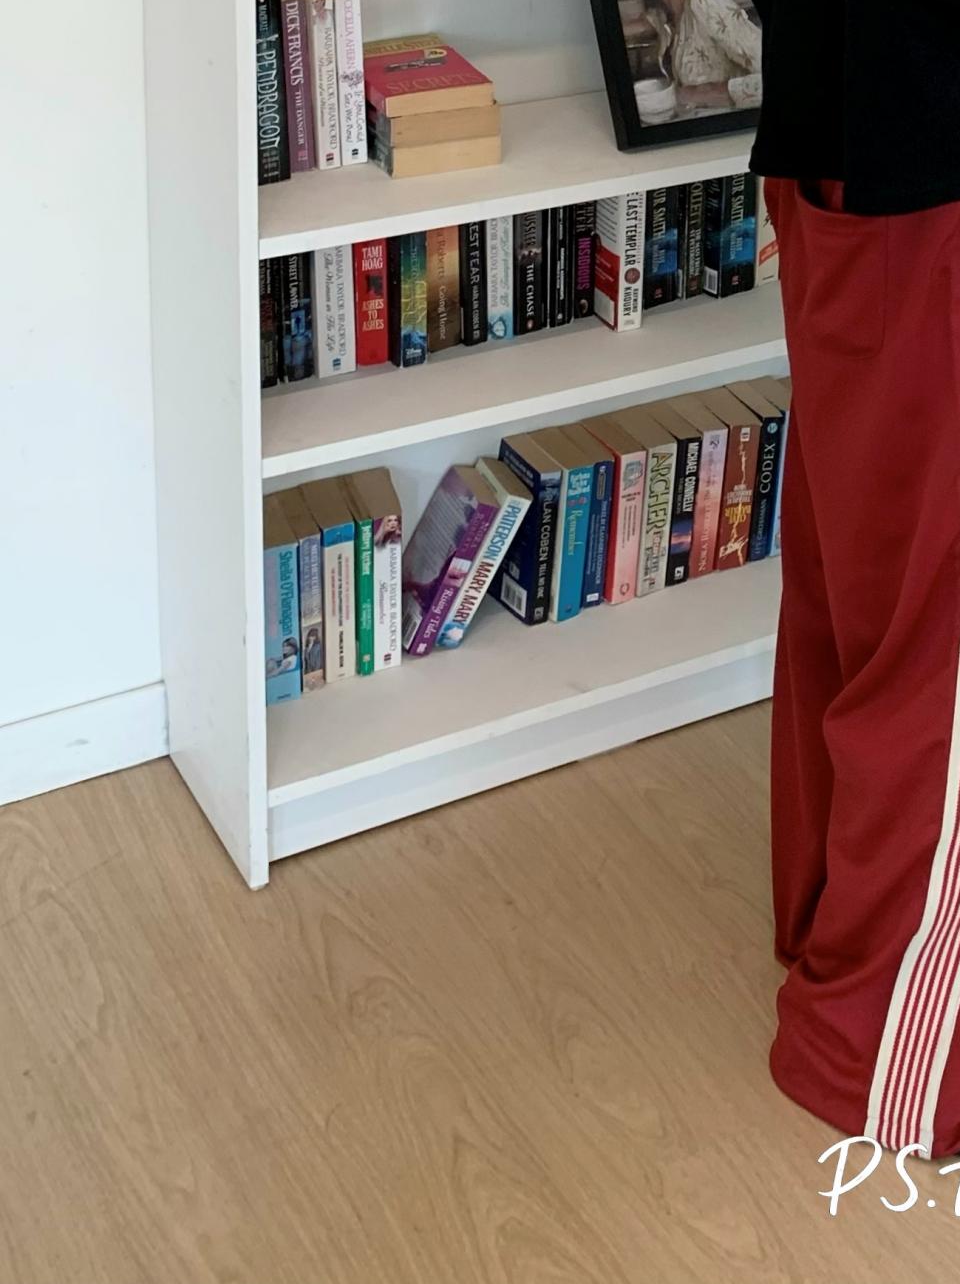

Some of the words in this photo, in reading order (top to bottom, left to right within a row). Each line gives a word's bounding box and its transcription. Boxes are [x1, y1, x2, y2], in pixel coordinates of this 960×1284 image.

[285, 1, 300, 34] DICK
[287, 35, 303, 86] FRANCIS
[387, 72, 483, 93] SECRETS
[257, 50, 280, 150] PENDRAGON
[294, 91, 302, 108] THE
[626, 199, 637, 222] LAST
[689, 184, 702, 226] OLLETT
[731, 195, 744, 227] SMITH
[652, 208, 665, 240] SMITH
[362, 246, 383, 258] TAMI
[625, 224, 637, 266] TEMPLAR
[361, 258, 383, 271] HOAG
[470, 251, 479, 284] FEAR
[526, 263, 534, 283] THE
[577, 237, 590, 290] INSIDIOUS
[362, 299, 384, 311] ASHES
[368, 311, 378, 320] TO
[526, 285, 535, 316] CHASE
[623, 287, 632, 316] KHOURY
[362, 320, 384, 332] ASHES
[439, 314, 448, 340] Home
[686, 442, 698, 475] MICHAEL
[759, 443, 776, 494] CODEX
[646, 453, 673, 534] ARCHER
[682, 476, 696, 512] CONNELLY
[483, 503, 522, 560] PATTERSON
[539, 525, 550, 562] COBEN
[279, 551, 293, 581] Sheila
[463, 561, 494, 598] MARY,
[279, 582, 294, 636] O'Flanagan
[537, 587, 545, 599] ONE
[453, 596, 477, 630] MARY
